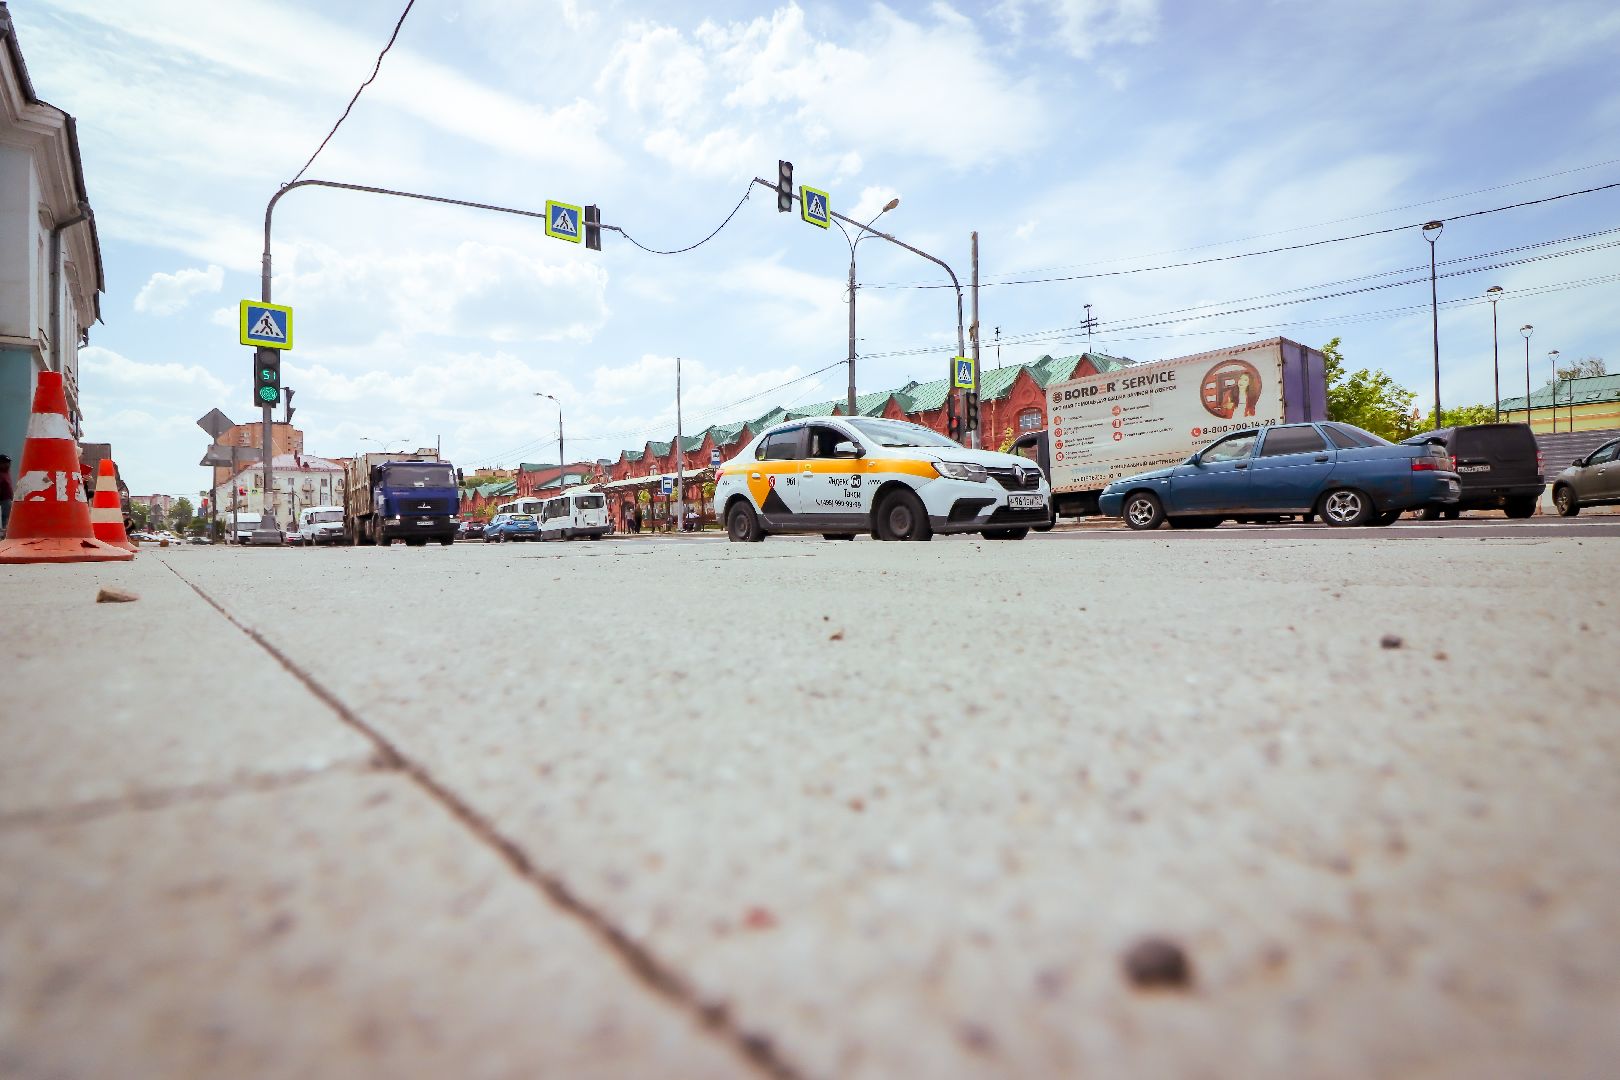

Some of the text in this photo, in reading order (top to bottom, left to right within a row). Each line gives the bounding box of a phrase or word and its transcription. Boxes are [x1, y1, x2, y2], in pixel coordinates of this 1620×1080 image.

[263, 370, 277, 380] 51
[1064, 370, 1176, 401] BORDER SERVICE
[844, 488, 861, 499] Такси
